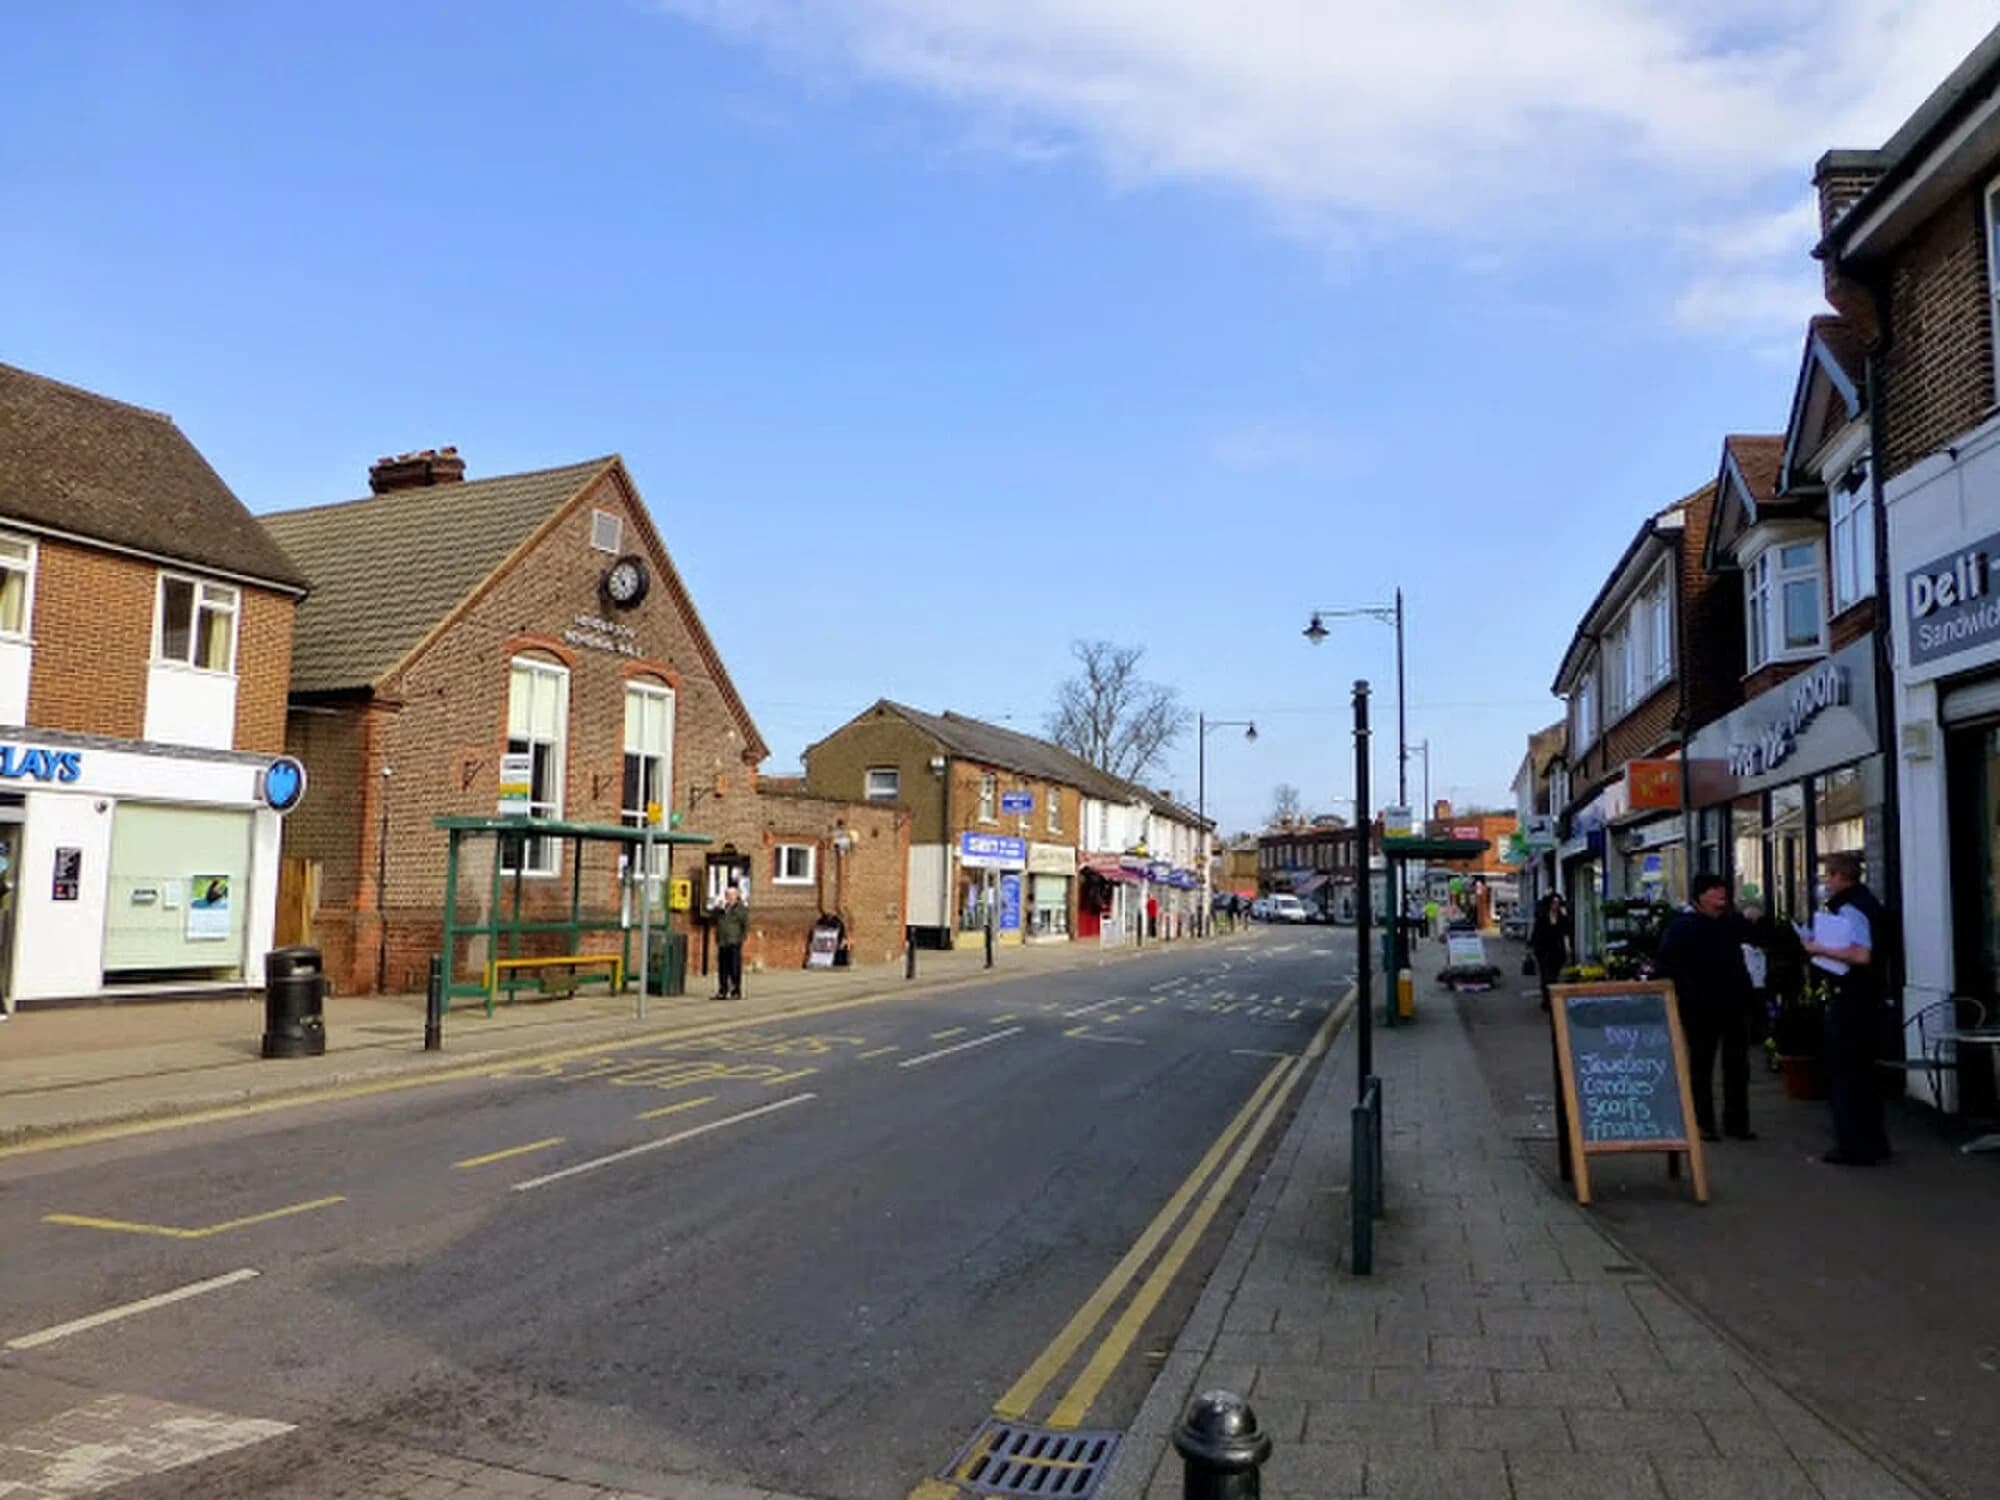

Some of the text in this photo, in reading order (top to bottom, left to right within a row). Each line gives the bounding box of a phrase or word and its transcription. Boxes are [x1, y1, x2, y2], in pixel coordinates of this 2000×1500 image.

[1911, 551, 1980, 620] Deli
[1919, 598, 2000, 651] Sandwic
[0, 746, 82, 783] LAYS
